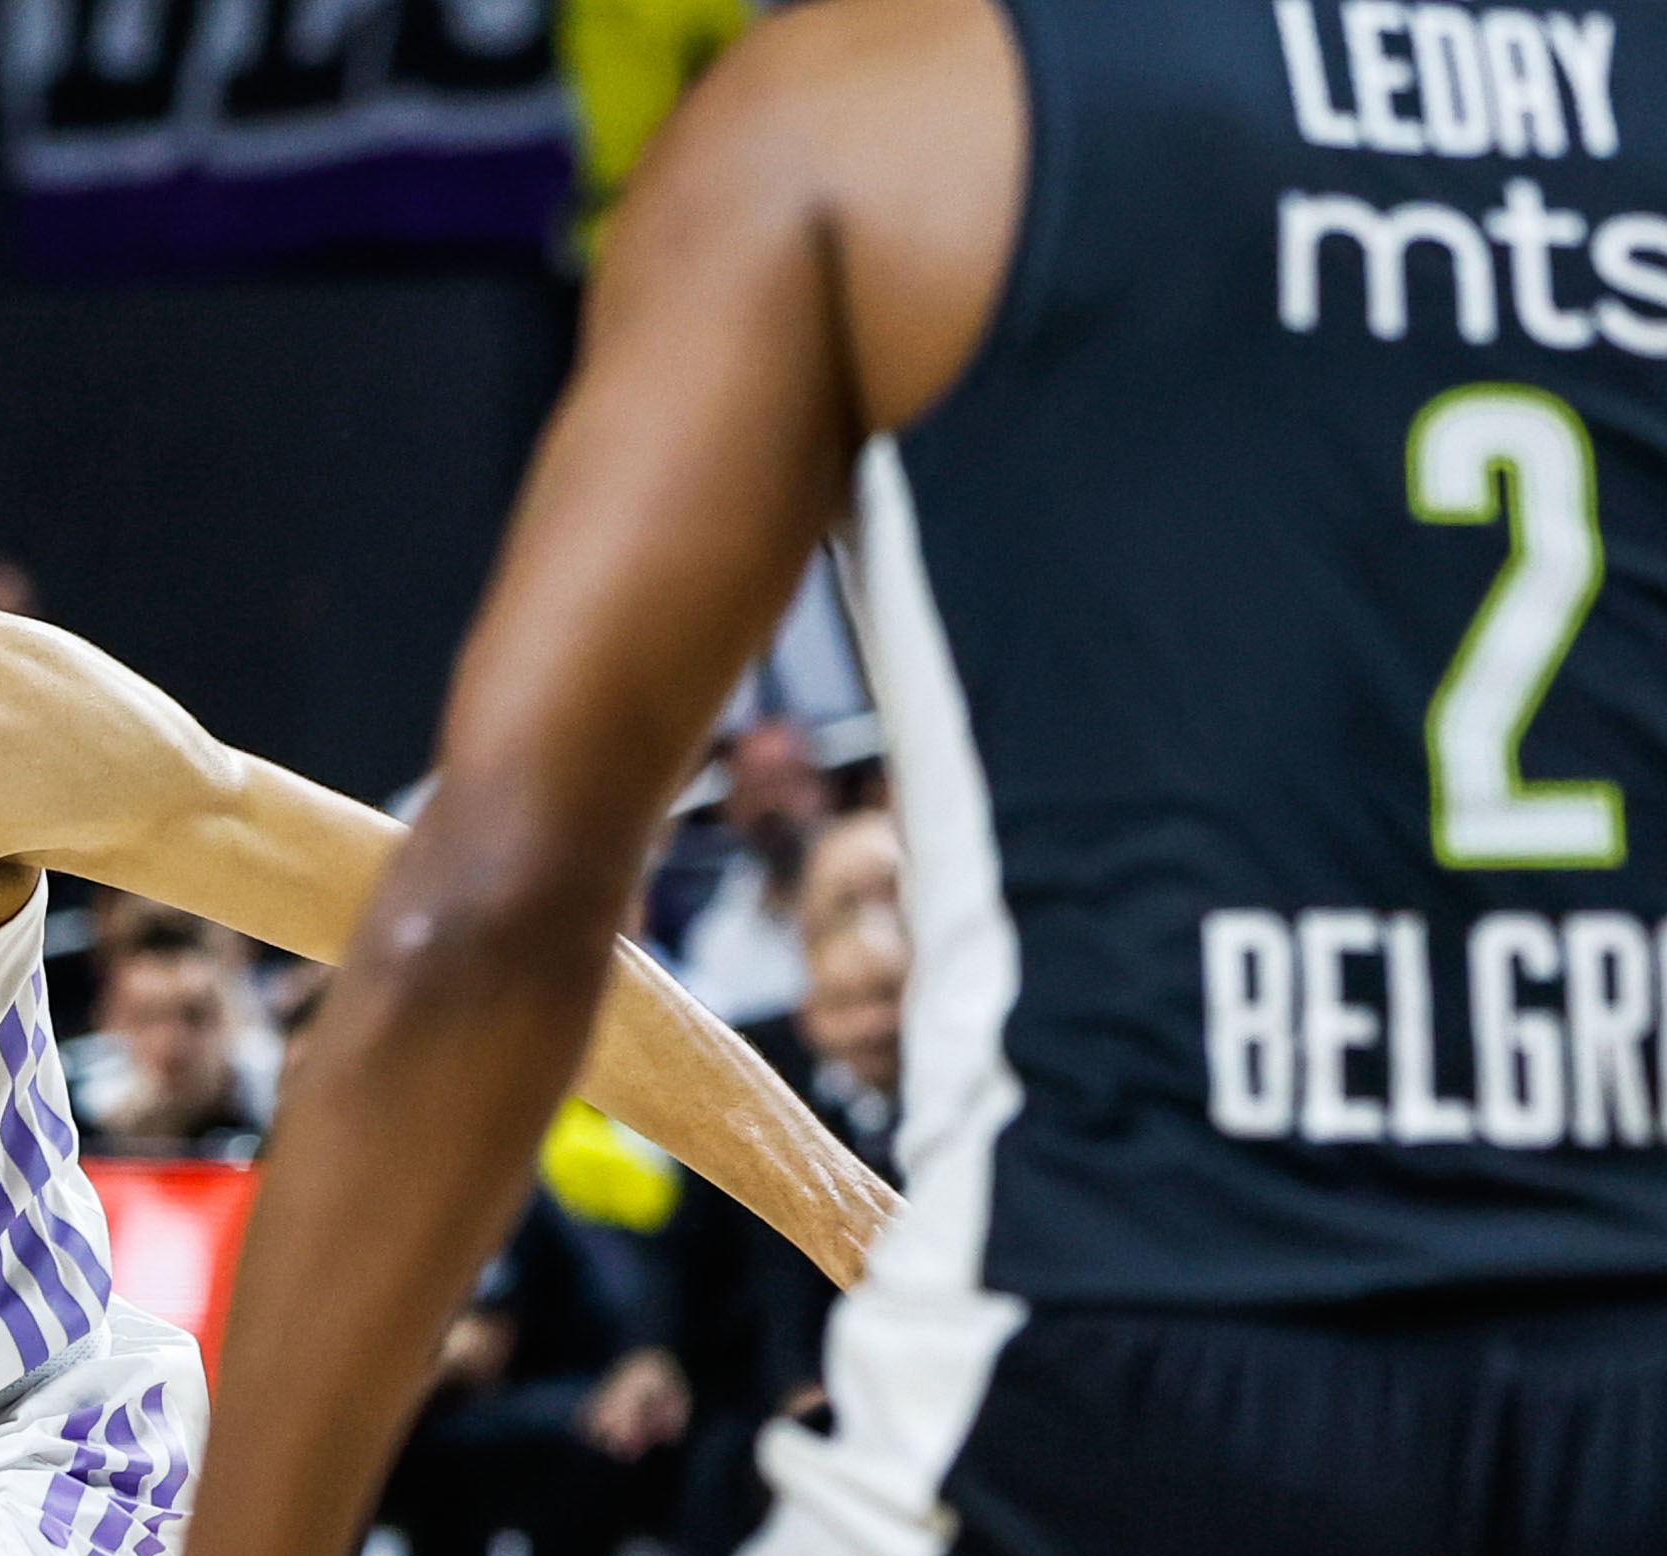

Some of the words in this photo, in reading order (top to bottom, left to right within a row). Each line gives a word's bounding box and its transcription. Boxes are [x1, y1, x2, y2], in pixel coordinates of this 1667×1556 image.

[1275, 0, 1620, 158] LEDAY
[1278, 177, 1667, 359] mts
[1406, 381, 1627, 869] 2
[1201, 906, 1667, 1149] BELGR
